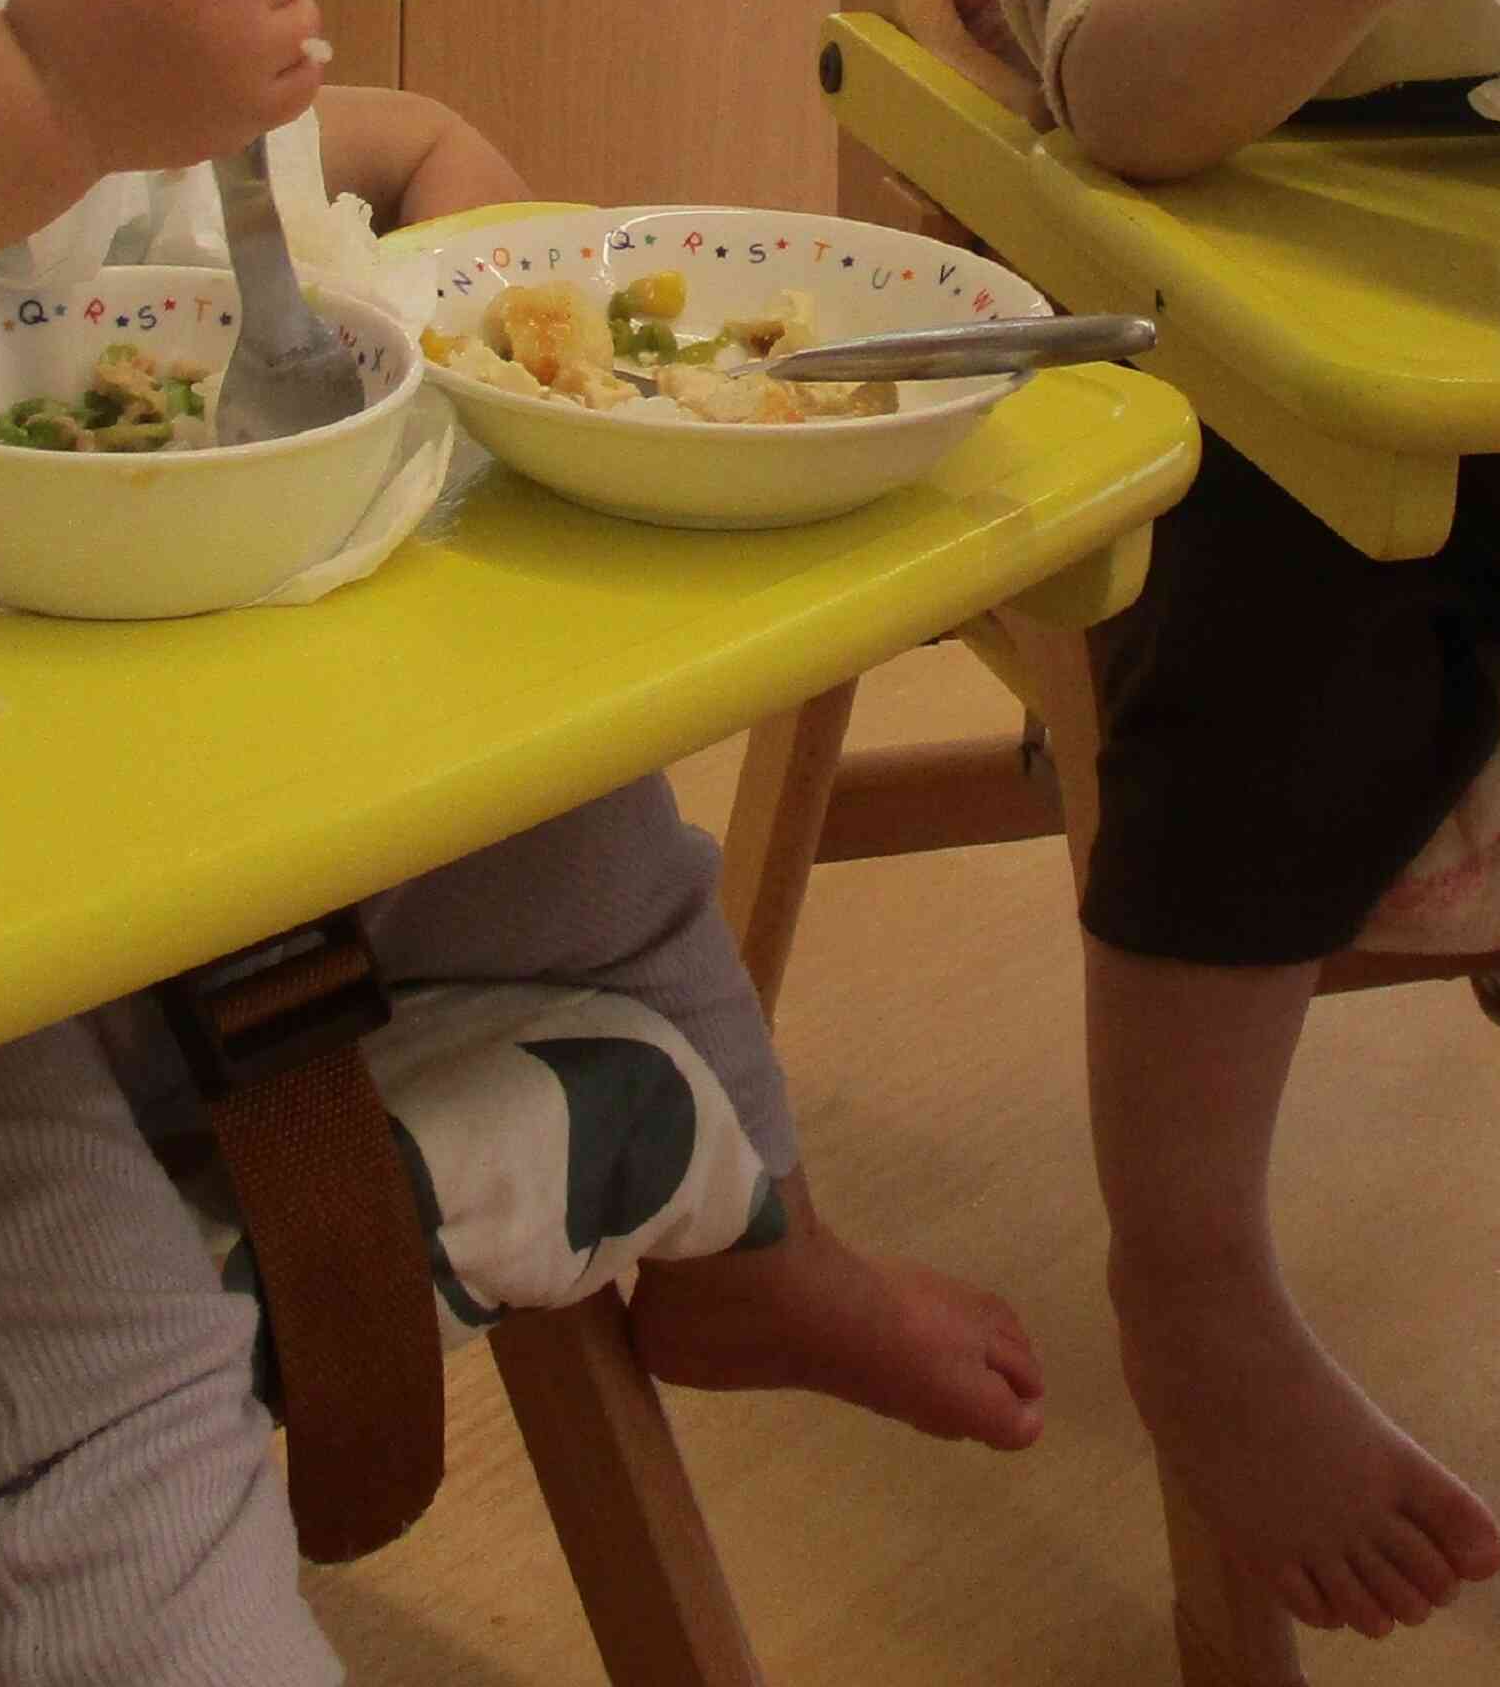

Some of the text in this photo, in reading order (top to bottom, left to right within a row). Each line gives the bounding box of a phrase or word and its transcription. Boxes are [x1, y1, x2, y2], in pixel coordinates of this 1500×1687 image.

[452, 270, 473, 296] N
[492, 247, 510, 268] O
[549, 248, 560, 270] P
[608, 230, 636, 250] Q
[682, 231, 703, 256] R
[749, 243, 767, 264] S
[813, 239, 832, 261] T
[871, 267, 892, 290] U
[938, 264, 957, 285] V
[18, 298, 49, 326] Q
[84, 298, 105, 325] R
[137, 305, 158, 330] S
[194, 296, 213, 322] T
